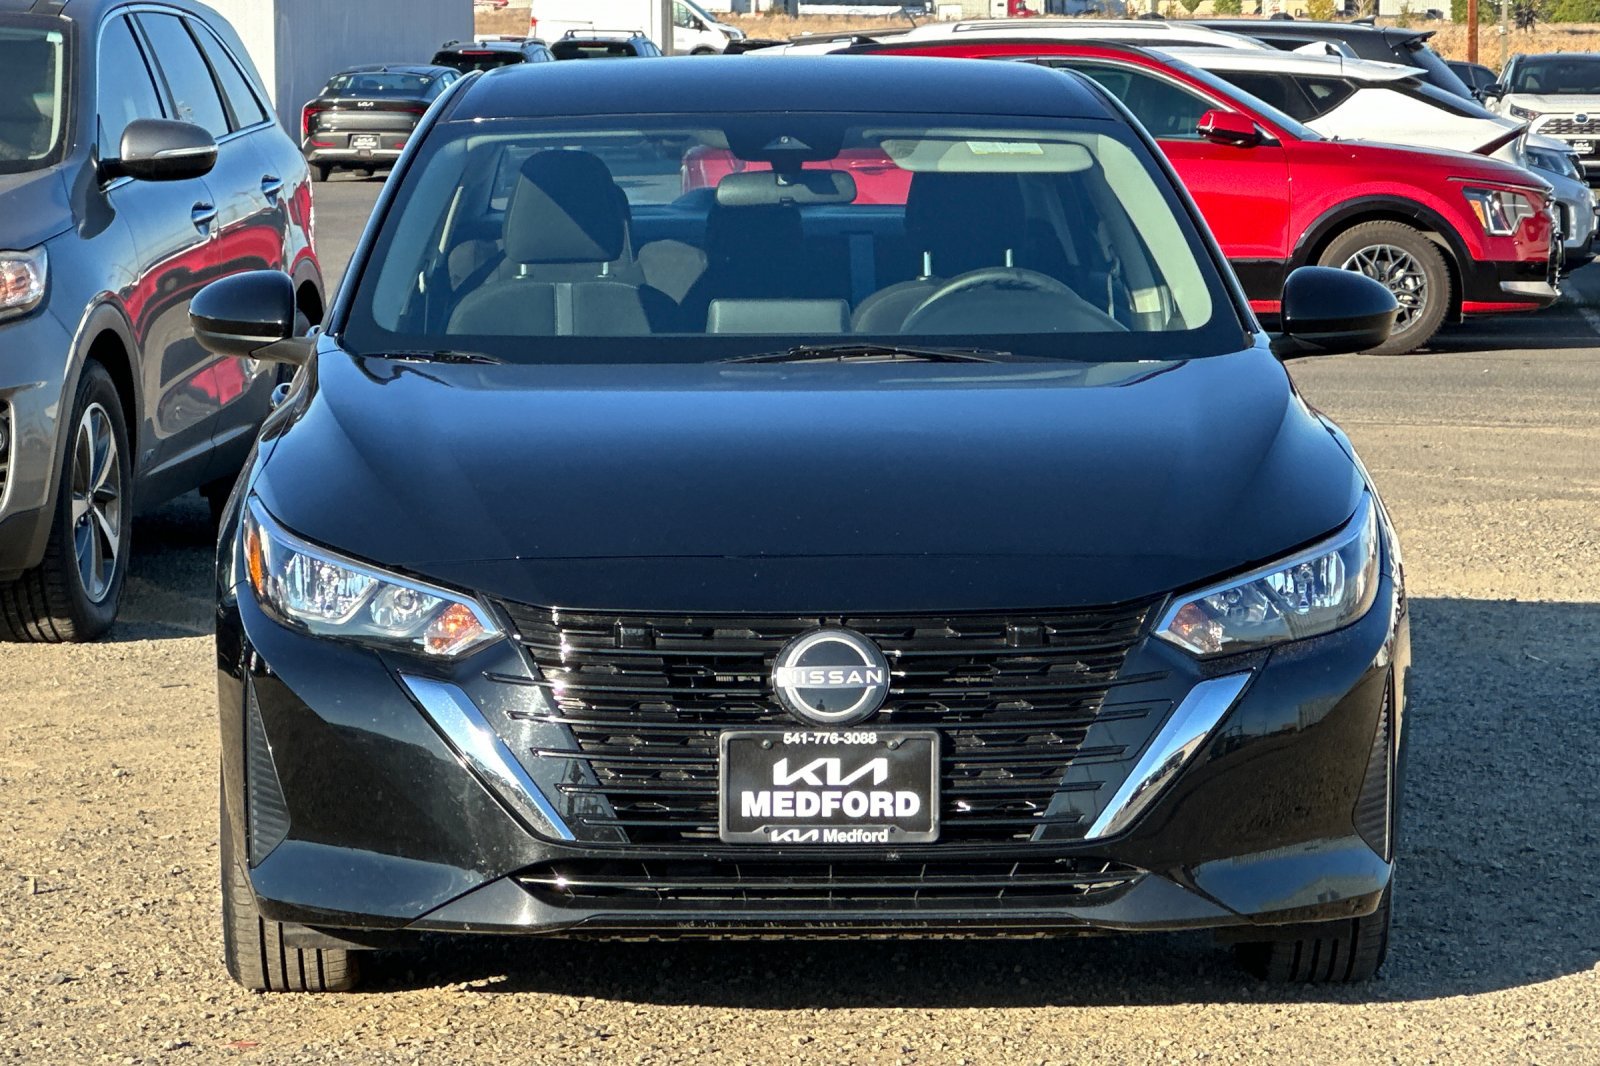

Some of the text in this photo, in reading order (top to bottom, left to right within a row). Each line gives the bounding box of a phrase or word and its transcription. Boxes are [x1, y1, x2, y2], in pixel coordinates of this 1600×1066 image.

[779, 670, 882, 684] NISSAN
[783, 732, 878, 745] 541-776-3088
[773, 757, 888, 786] KIA
[741, 790, 921, 818] MEDFORD
[771, 828, 889, 843] KIA Medford
